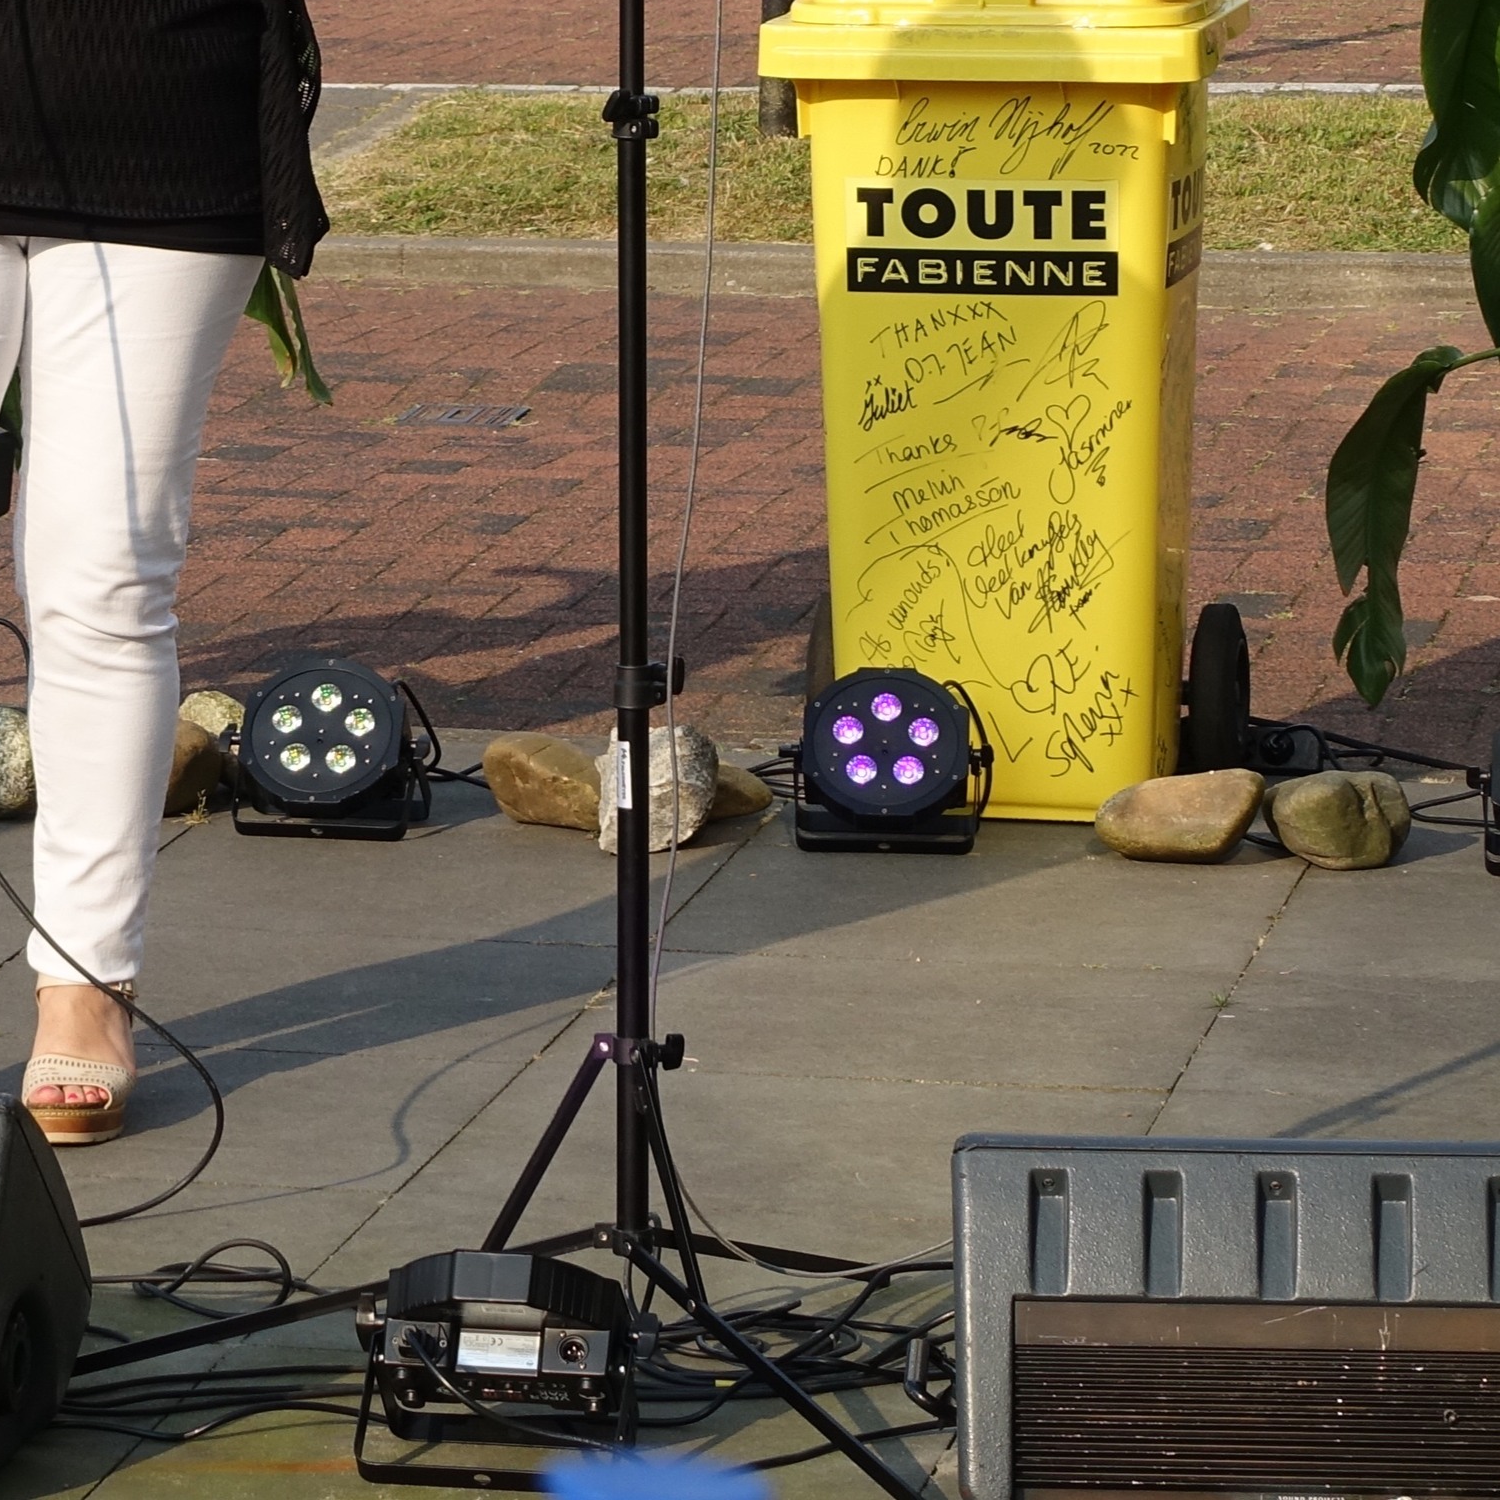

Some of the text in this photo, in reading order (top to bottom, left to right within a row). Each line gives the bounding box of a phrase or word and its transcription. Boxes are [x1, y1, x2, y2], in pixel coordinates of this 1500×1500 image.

[856, 186, 1108, 242] TOUTE
[856, 257, 1108, 288] FABIENNE
[854, 433, 958, 465] Thanks
